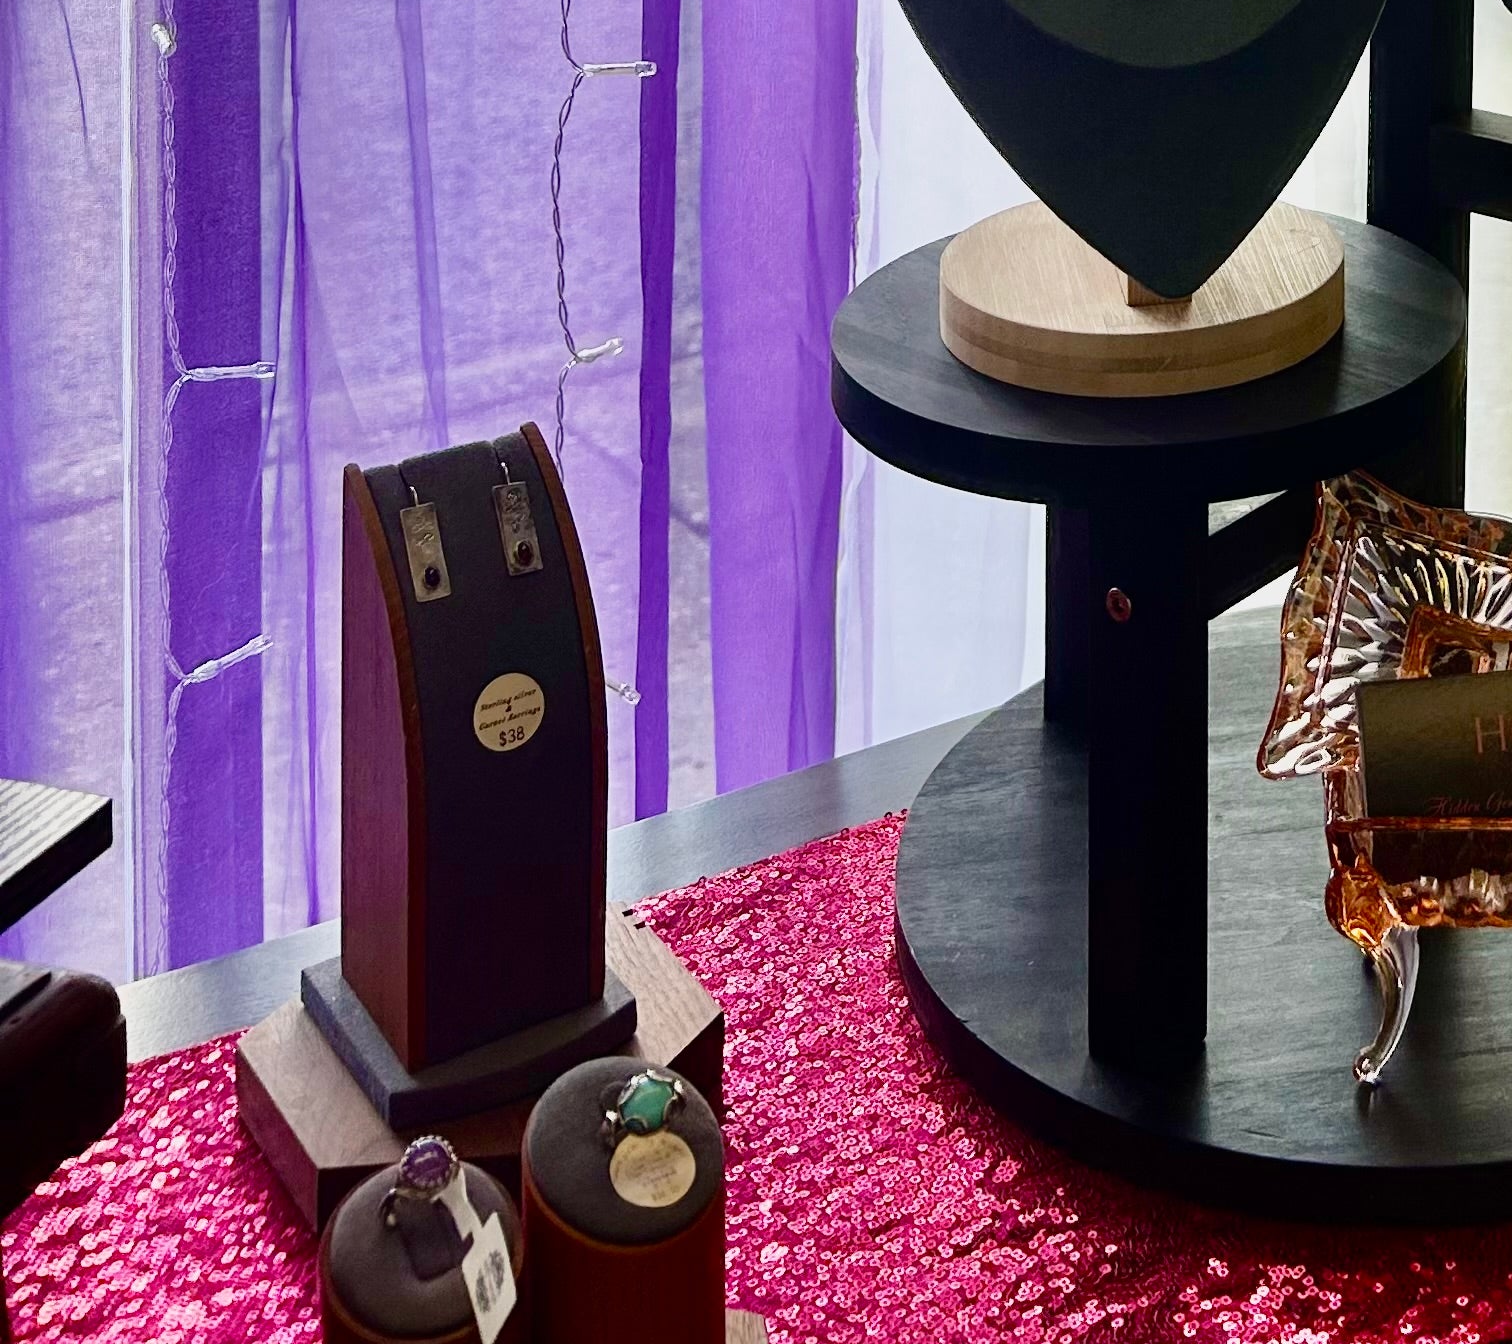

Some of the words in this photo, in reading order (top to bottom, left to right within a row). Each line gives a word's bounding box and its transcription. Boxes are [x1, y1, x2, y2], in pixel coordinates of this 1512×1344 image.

[480, 697, 512, 711] Sterling
[479, 717, 506, 730] Garnet
[499, 725, 525, 747] $38
[1427, 796, 1480, 815] Hidden
